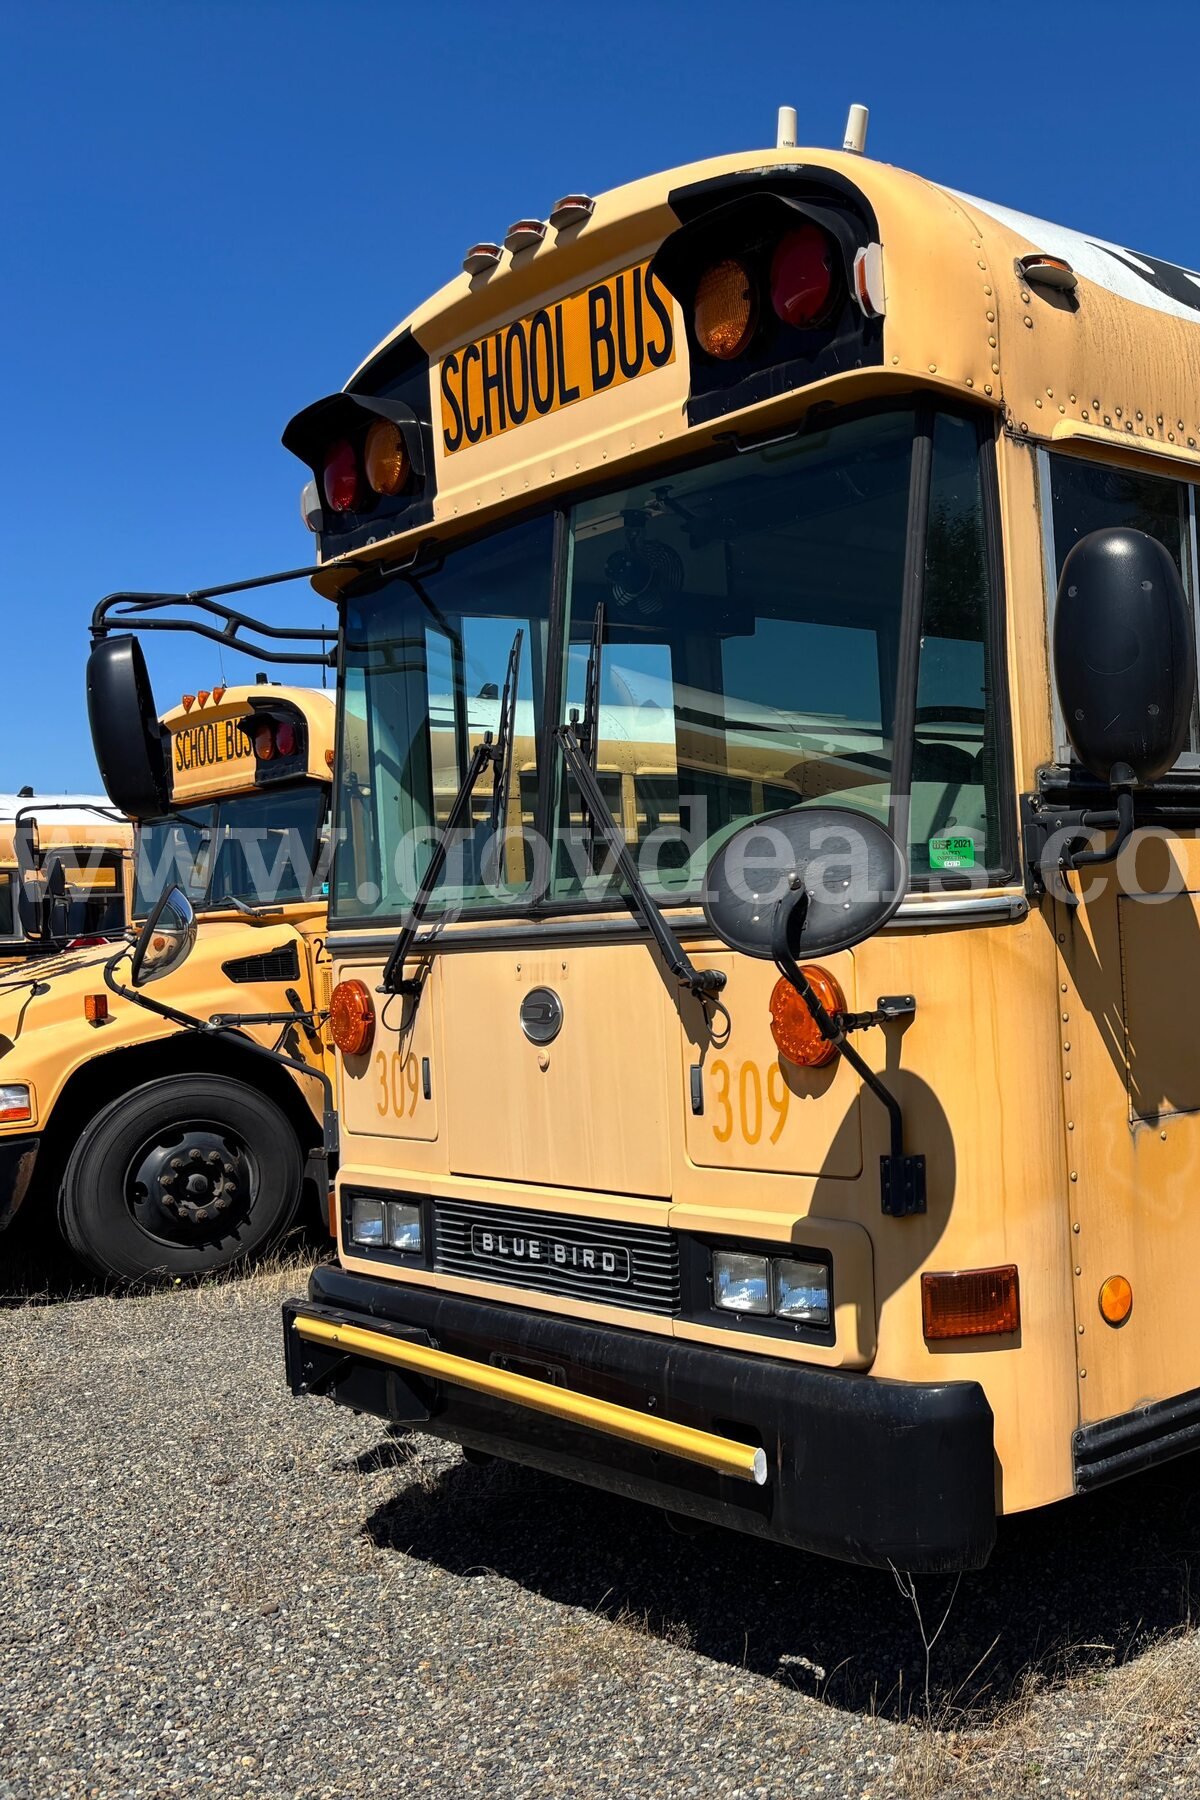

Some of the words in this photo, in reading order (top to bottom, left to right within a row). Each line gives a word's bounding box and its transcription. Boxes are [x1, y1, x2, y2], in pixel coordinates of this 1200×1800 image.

[441, 304, 580, 452] SCHOOL
[588, 260, 674, 392] BUS
[175, 723, 223, 771] SCHOOL
[954, 840, 971, 848] 2021
[376, 1050, 419, 1119] 309
[710, 1059, 790, 1147] 309
[482, 1232, 541, 1260] BLUE
[554, 1245, 616, 1272] BIRD
